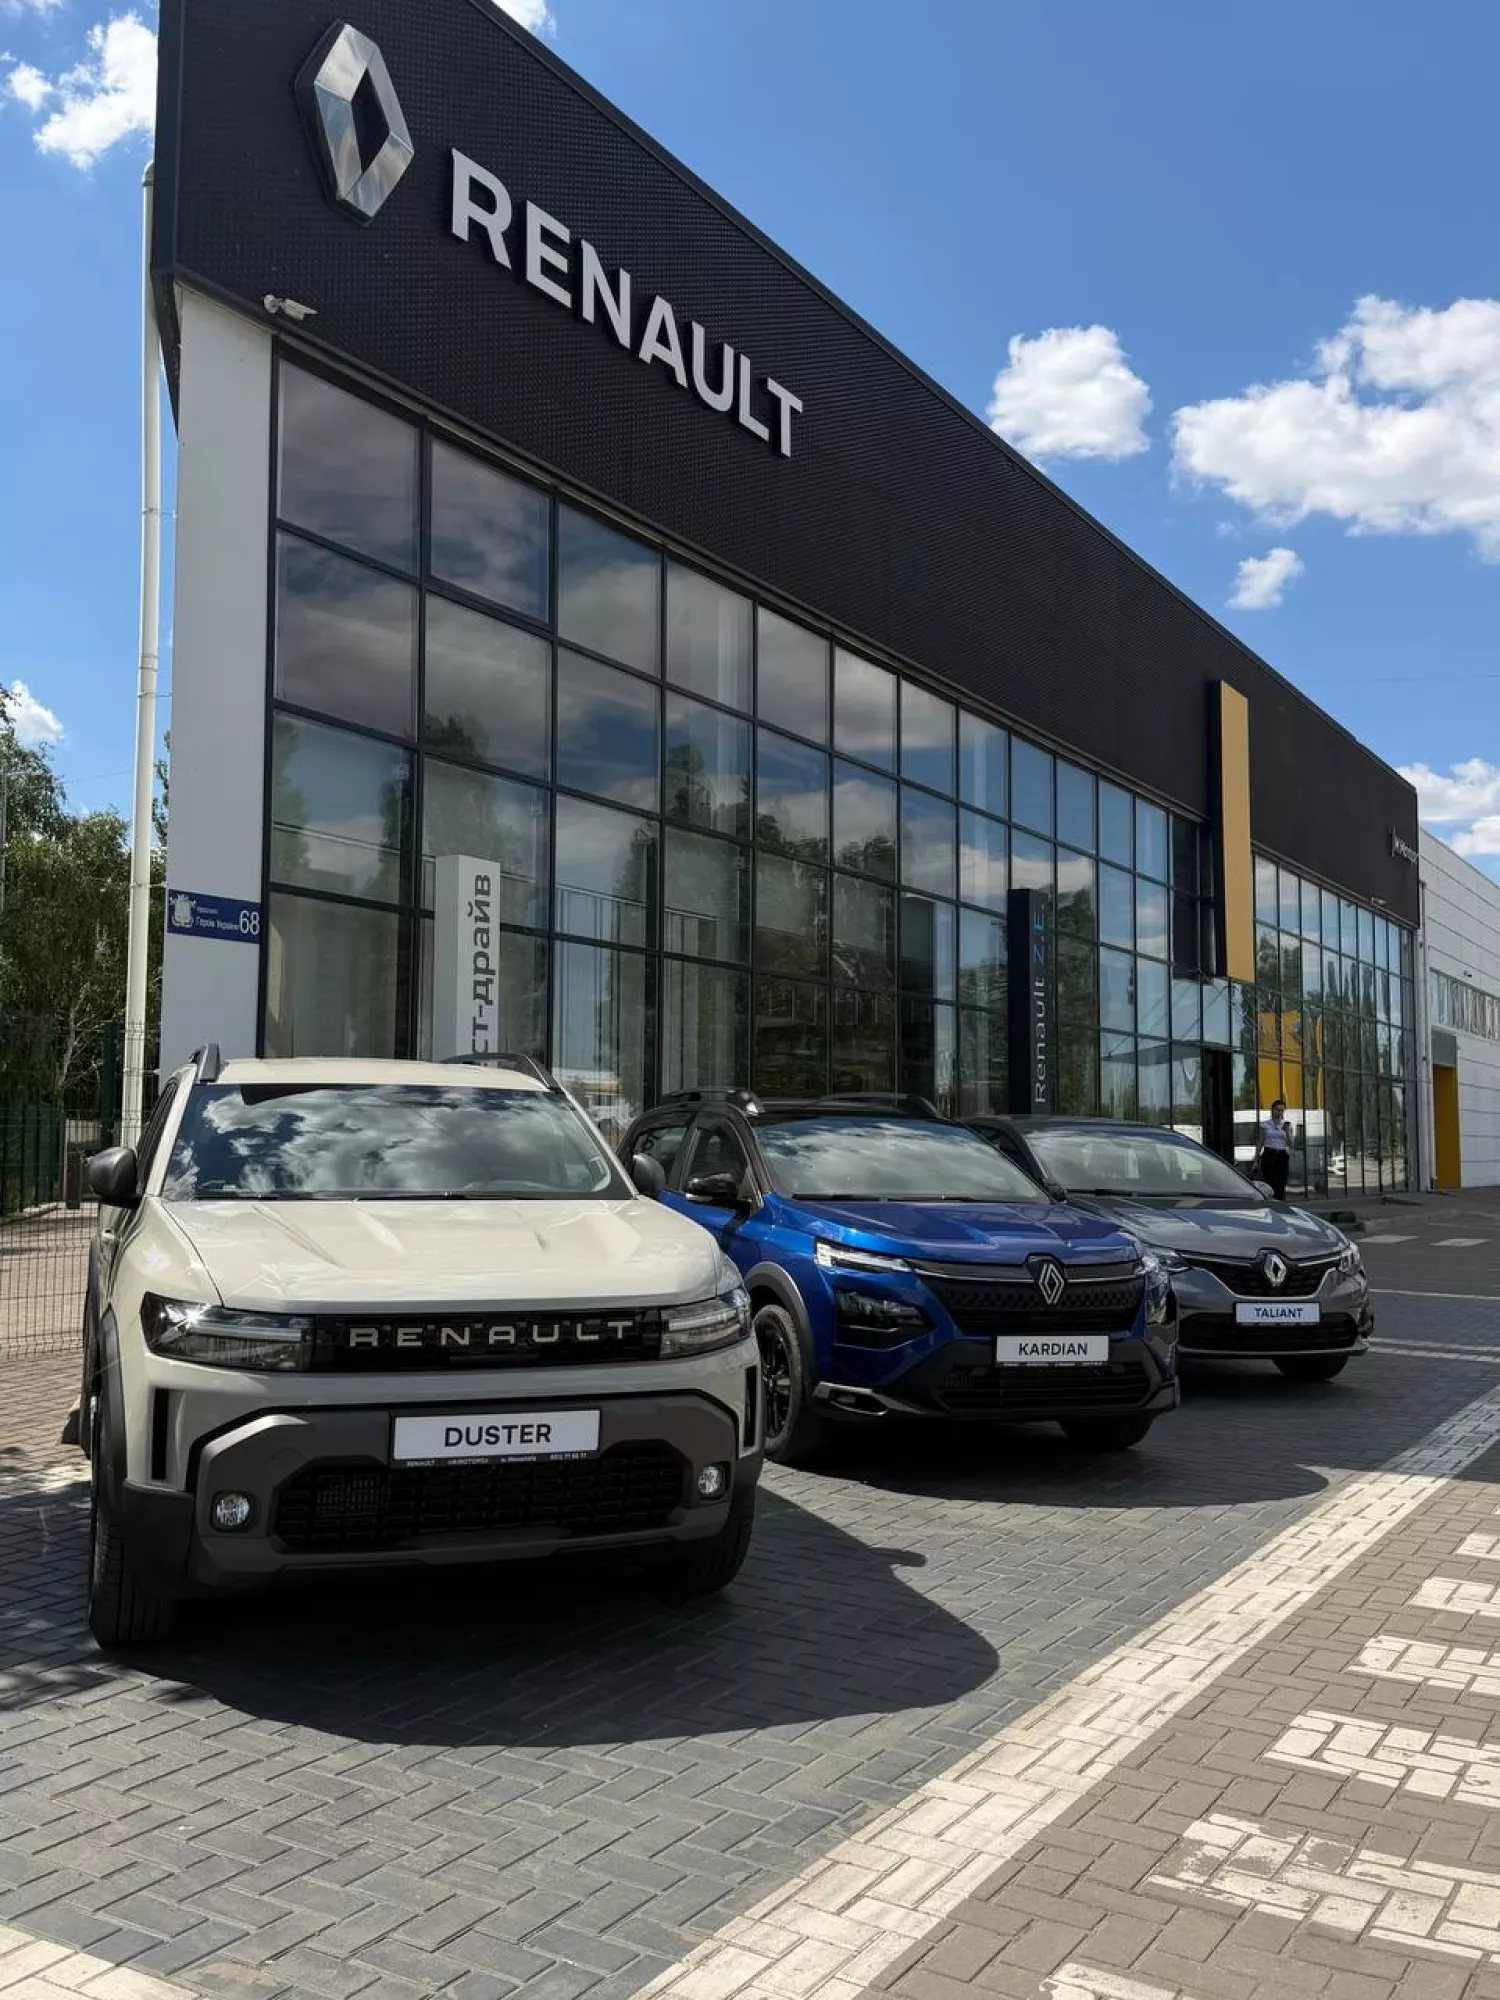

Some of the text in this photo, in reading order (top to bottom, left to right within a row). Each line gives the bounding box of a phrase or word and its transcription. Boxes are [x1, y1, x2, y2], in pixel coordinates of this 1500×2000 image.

[452, 148, 803, 459] RENAULT
[240, 910, 260, 935] 68
[467, 874, 496, 1054] ст-драйв
[1034, 976, 1047, 1104] Renault
[1254, 1307, 1303, 1318] TALIANT
[349, 1320, 634, 1348] RENAULT
[1019, 1342, 1088, 1356] KARDIAN
[444, 1423, 551, 1448] DUSTER
